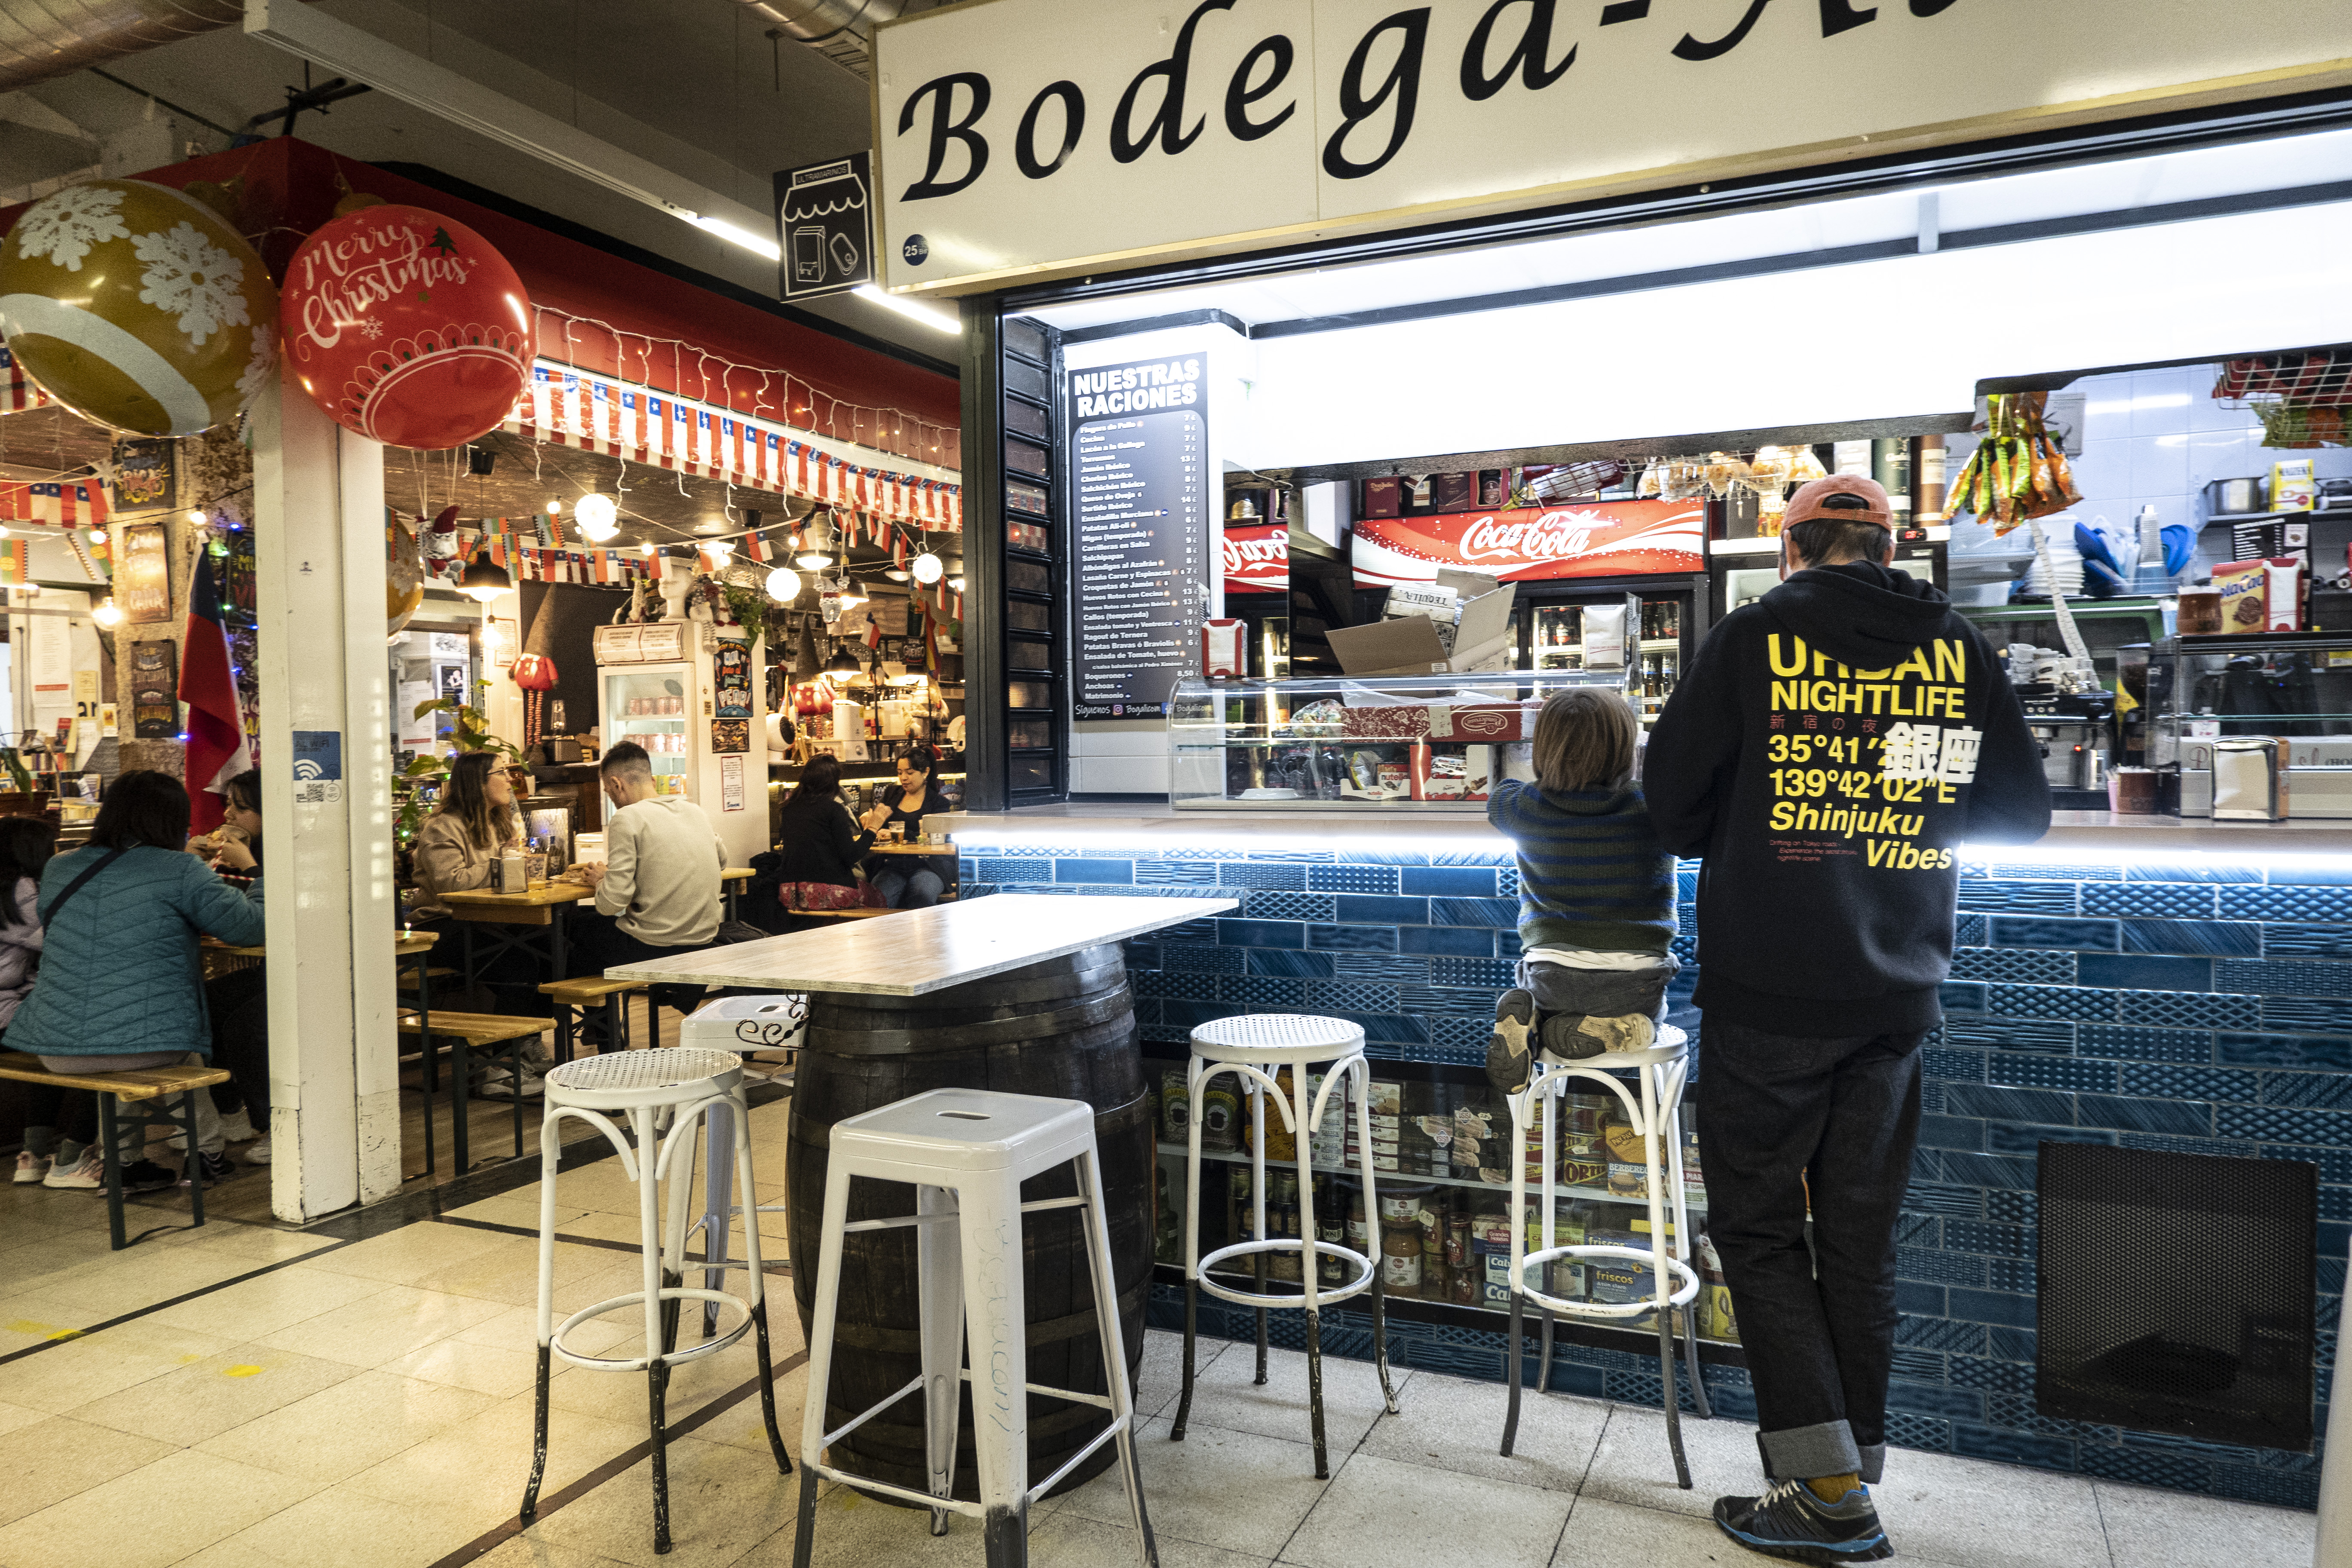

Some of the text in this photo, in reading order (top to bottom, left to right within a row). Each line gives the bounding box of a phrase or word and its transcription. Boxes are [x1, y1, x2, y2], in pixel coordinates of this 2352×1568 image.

[897, 0, 1961, 203] Bodega-
[796, 166, 847, 183] ULTRAMARINOS
[301, 220, 426, 290] Merry
[904, 245, 918, 257] 25
[296, 254, 469, 362] Christmas
[1075, 359, 1200, 396] NUESTRAS
[1078, 383, 1197, 417] RACIONES
[1103, 530, 1146, 541] (temporada)
[1458, 509, 1600, 560] Coca-Cola
[1406, 591, 1448, 606] TEQUILA
[2219, 574, 2263, 598] olaCao
[1106, 611, 1149, 621] (temporada)
[1768, 634, 1966, 683] UAN
[1075, 705, 1111, 718] Síguenos
[1175, 704, 1210, 716] Bogalico
[1771, 680, 1966, 719] NIGHTLIFE
[1769, 714, 1877, 733] 新宿の夜
[1883, 722, 1983, 784] 銀座
[1769, 802, 1924, 839] Shinjuku
[1867, 839, 1952, 870] Vibes
[1609, 1163, 1665, 1176] BERBERECS
[1596, 1271, 1633, 1284] friscos
